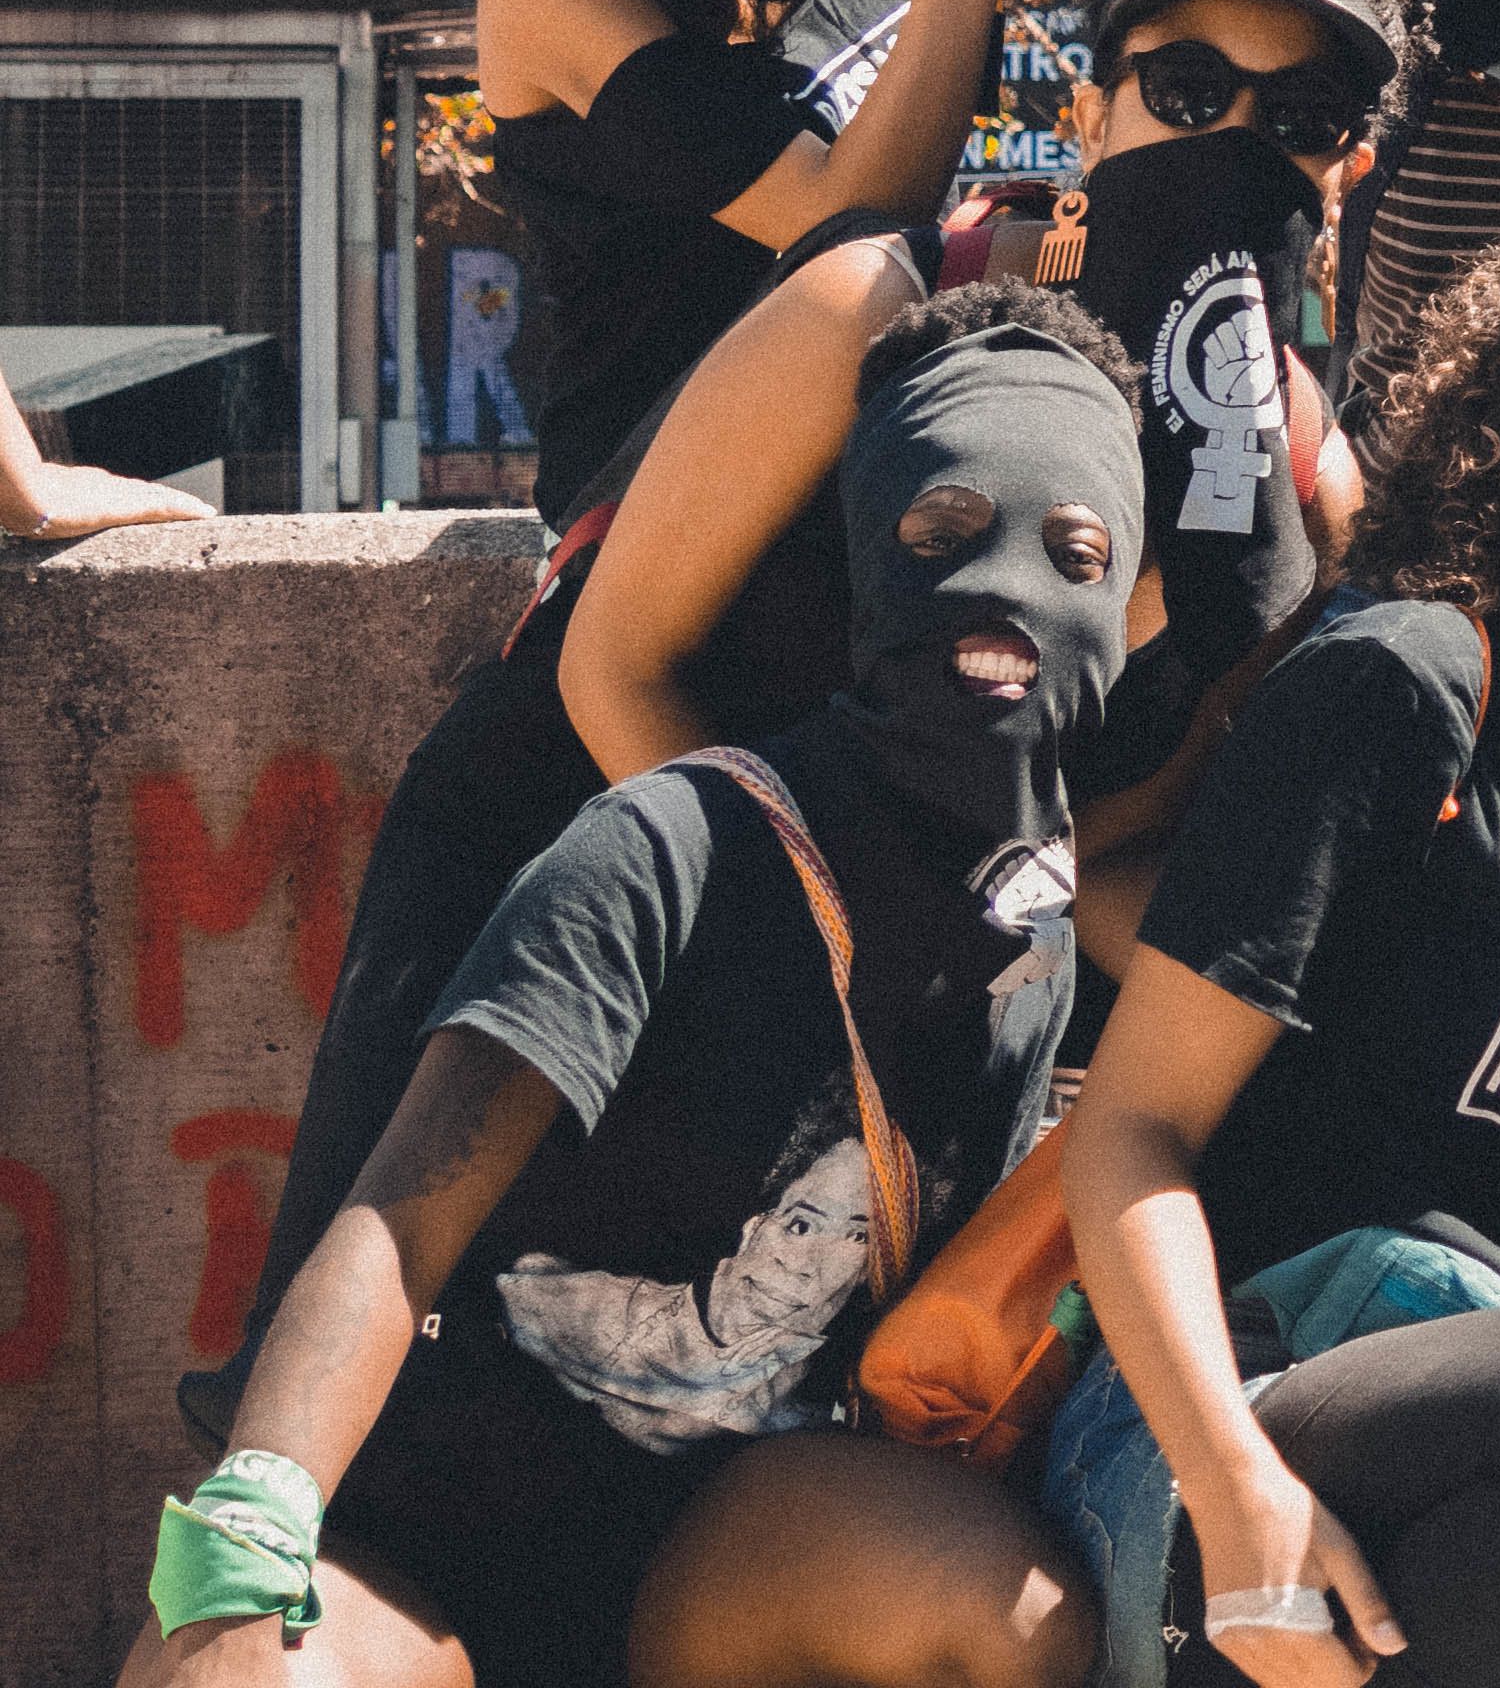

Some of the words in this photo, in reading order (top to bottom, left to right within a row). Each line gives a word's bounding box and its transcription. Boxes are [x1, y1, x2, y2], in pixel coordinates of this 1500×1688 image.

[1183, 252, 1223, 296] SERÁ
[1151, 300, 1185, 408] FEMINISMO
[1165, 408, 1185, 434] EL
